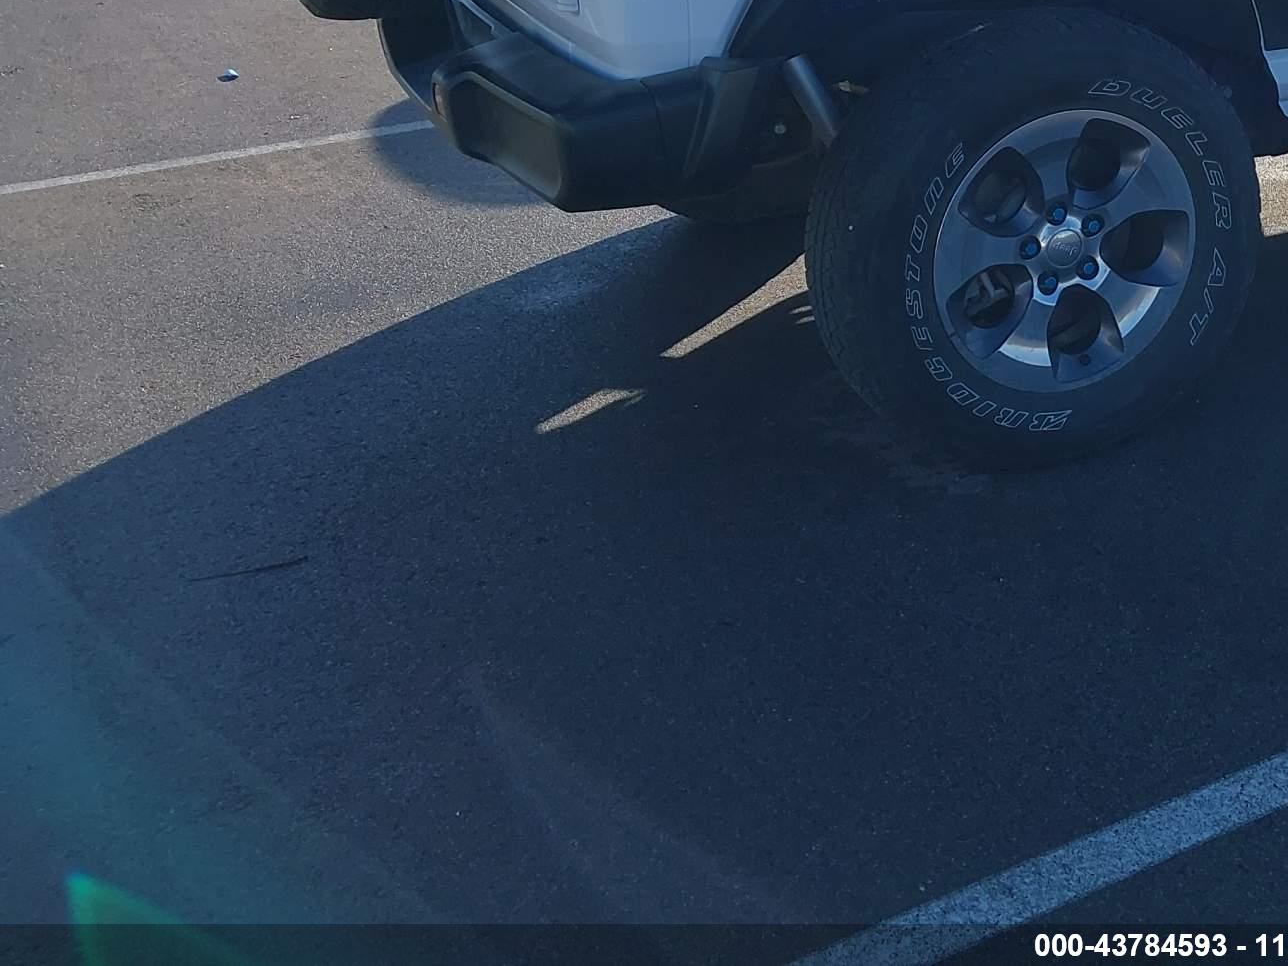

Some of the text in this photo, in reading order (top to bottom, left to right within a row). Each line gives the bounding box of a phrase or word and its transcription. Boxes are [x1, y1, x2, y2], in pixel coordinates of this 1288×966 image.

[904, 142, 1072, 431] BRIDGESTONE
[1087, 80, 1233, 347] DUELER A/T
